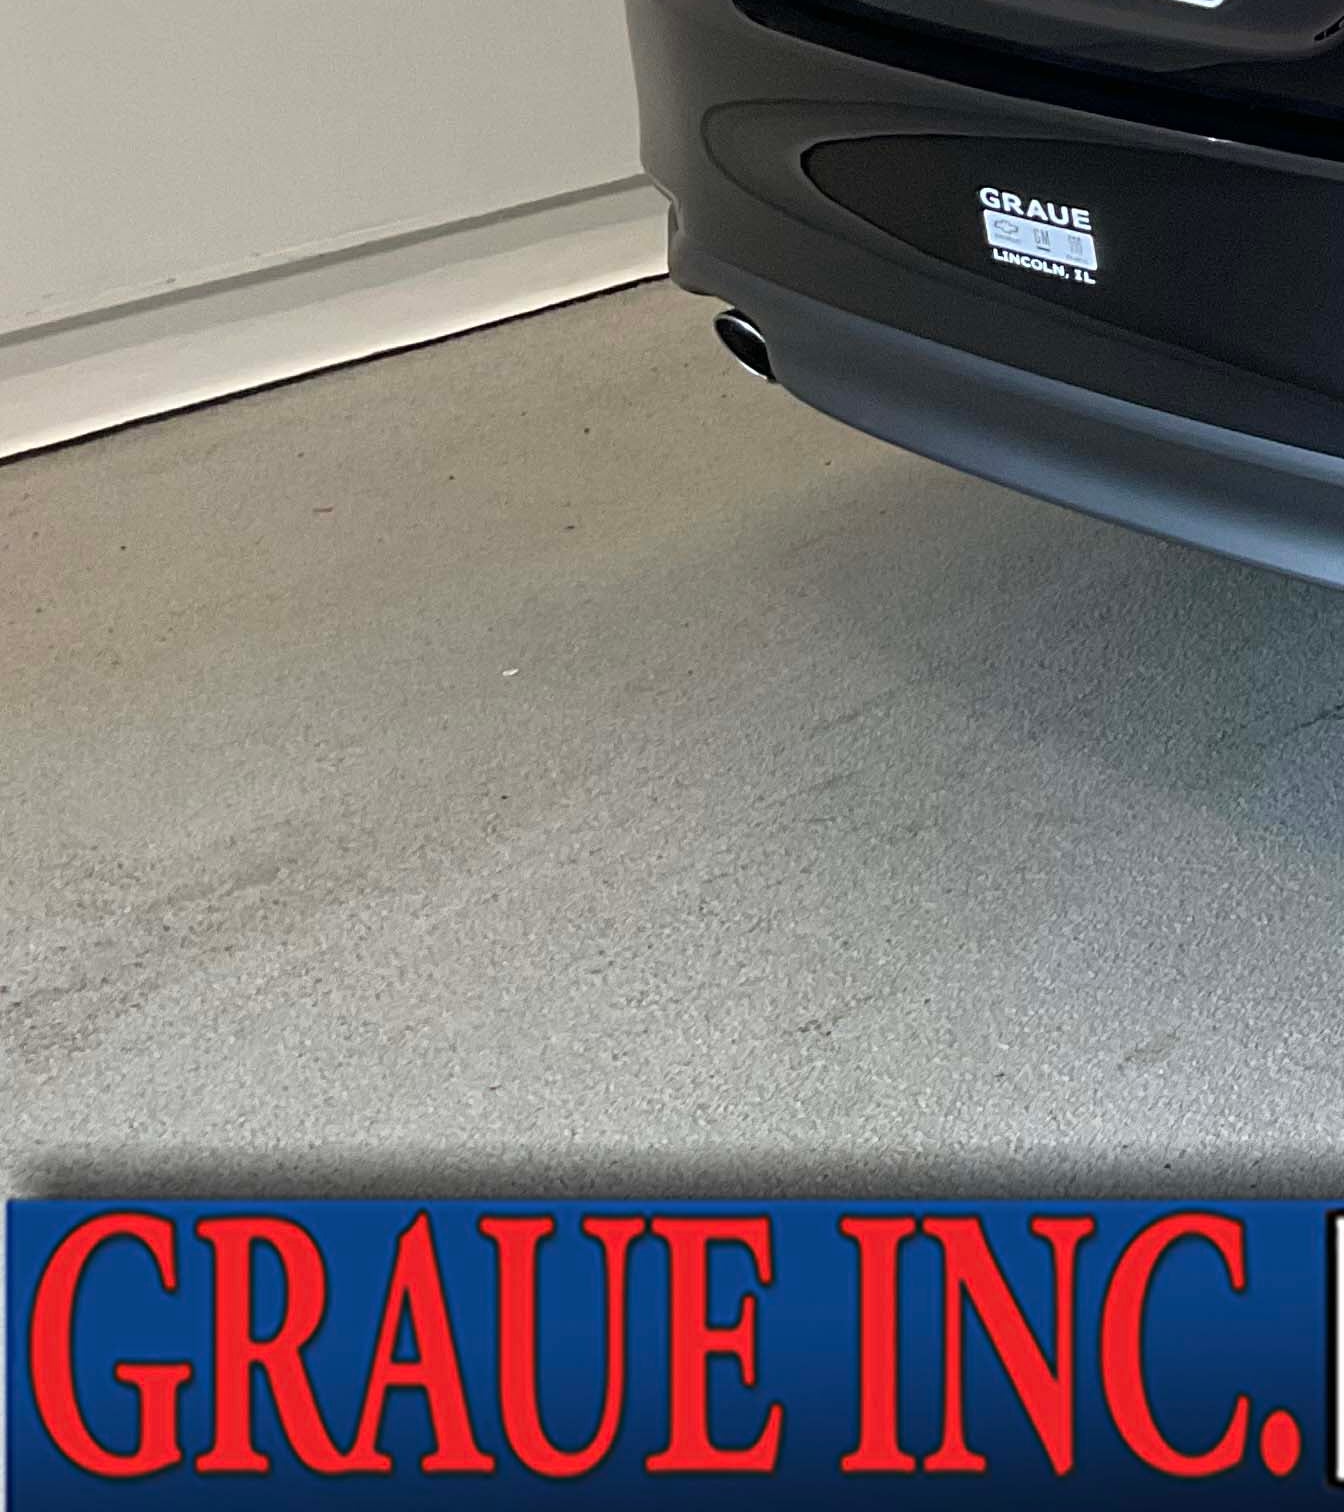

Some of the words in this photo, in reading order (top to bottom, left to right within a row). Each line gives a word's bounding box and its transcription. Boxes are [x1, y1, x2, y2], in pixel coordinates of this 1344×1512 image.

[979, 187, 1092, 231] GRAUE
[992, 248, 1070, 280] LINCOLN,
[1074, 269, 1097, 285] IL
